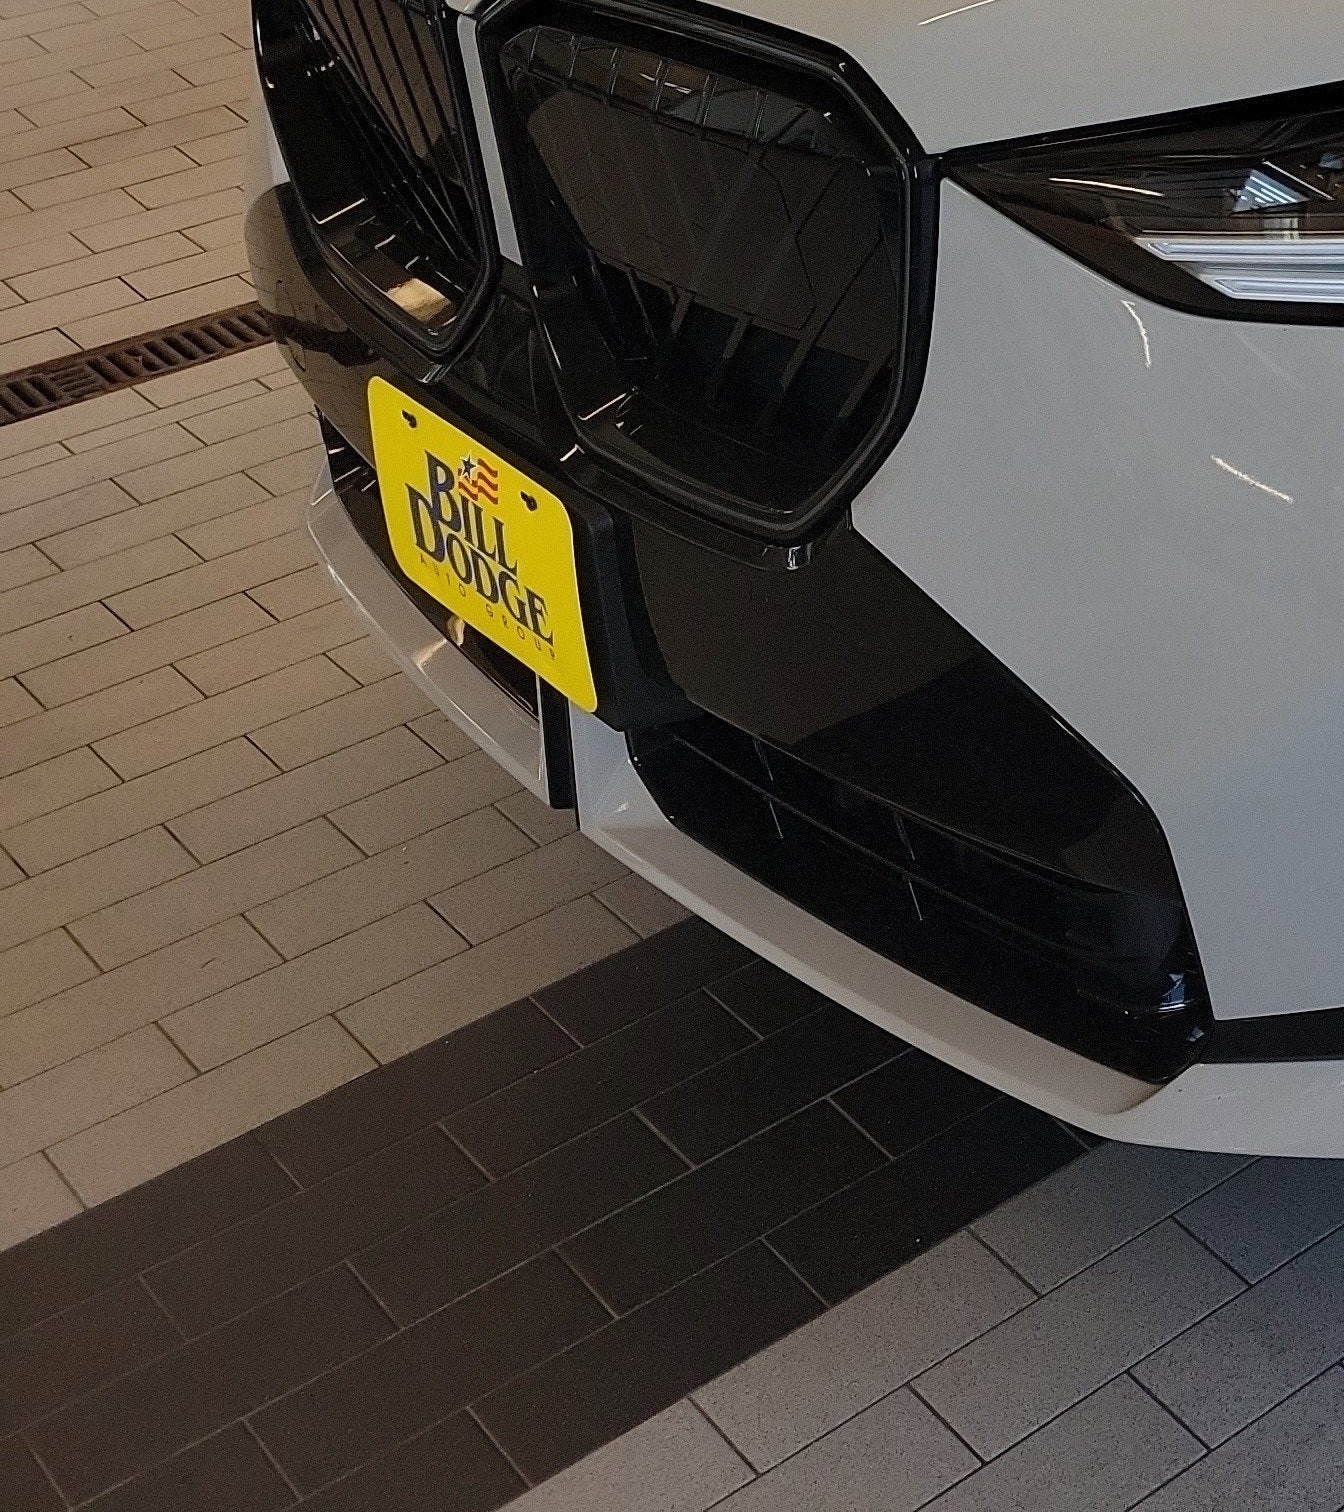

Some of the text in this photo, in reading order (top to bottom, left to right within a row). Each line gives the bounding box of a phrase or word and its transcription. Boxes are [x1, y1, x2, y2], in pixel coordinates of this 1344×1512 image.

[404, 482, 554, 645] DODGE
[424, 449, 518, 578] BILL
[420, 553, 556, 661] AUTO GROUP
